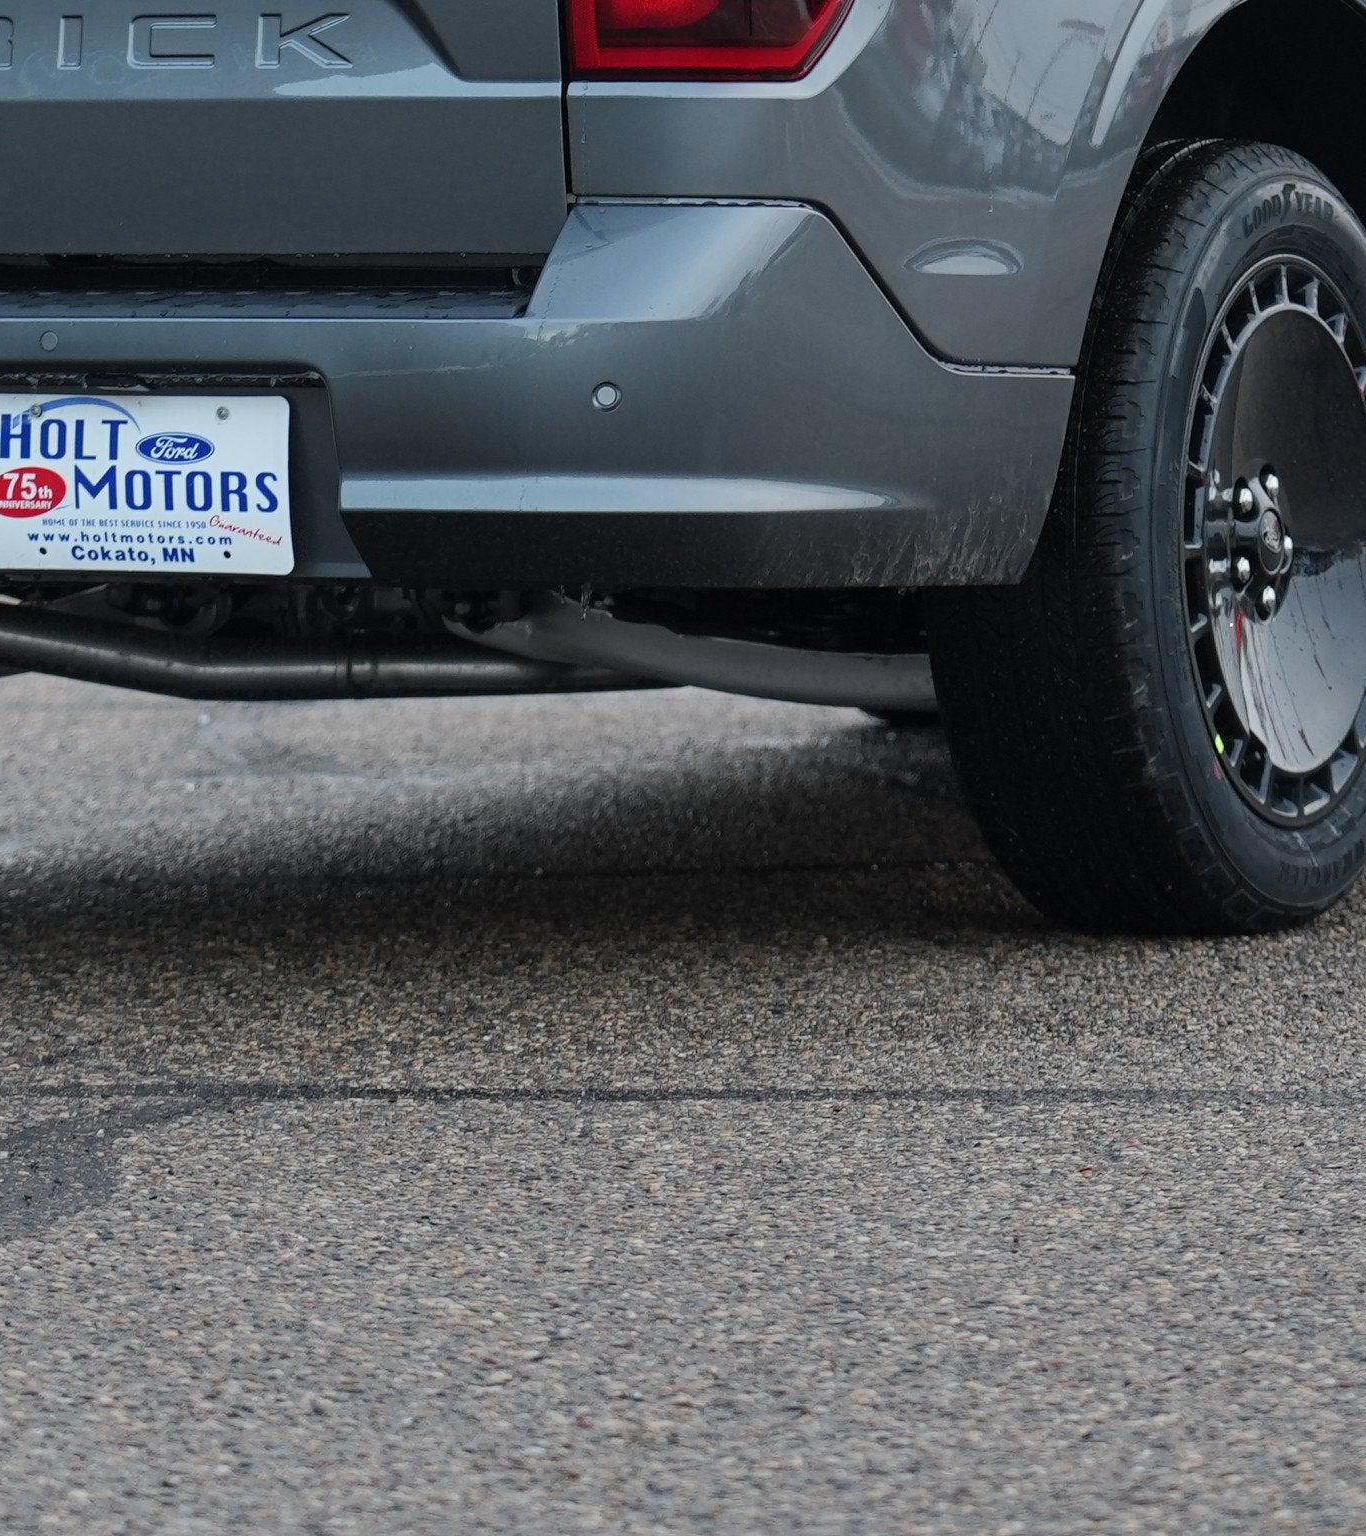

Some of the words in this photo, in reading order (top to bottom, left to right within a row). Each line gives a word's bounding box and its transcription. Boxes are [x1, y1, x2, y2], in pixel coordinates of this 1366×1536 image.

[0, 414, 128, 461] HOLT
[150, 436, 198, 461] Ford
[3, 473, 53, 500] 75th
[75, 464, 279, 513] MOTORS
[42, 518, 66, 527] HOME
[69, 518, 78, 527] OF
[82, 519, 96, 527] THE
[99, 519, 118, 527] BEST
[121, 519, 154, 528] SERVICE
[158, 520, 182, 529] SINCE
[186, 520, 207, 529] 1950
[209, 515, 283, 546] Guaranteed
[27, 531, 233, 545] www.holtmotors.com
[71, 545, 156, 564] Cokato,
[163, 548, 196, 562] MN
